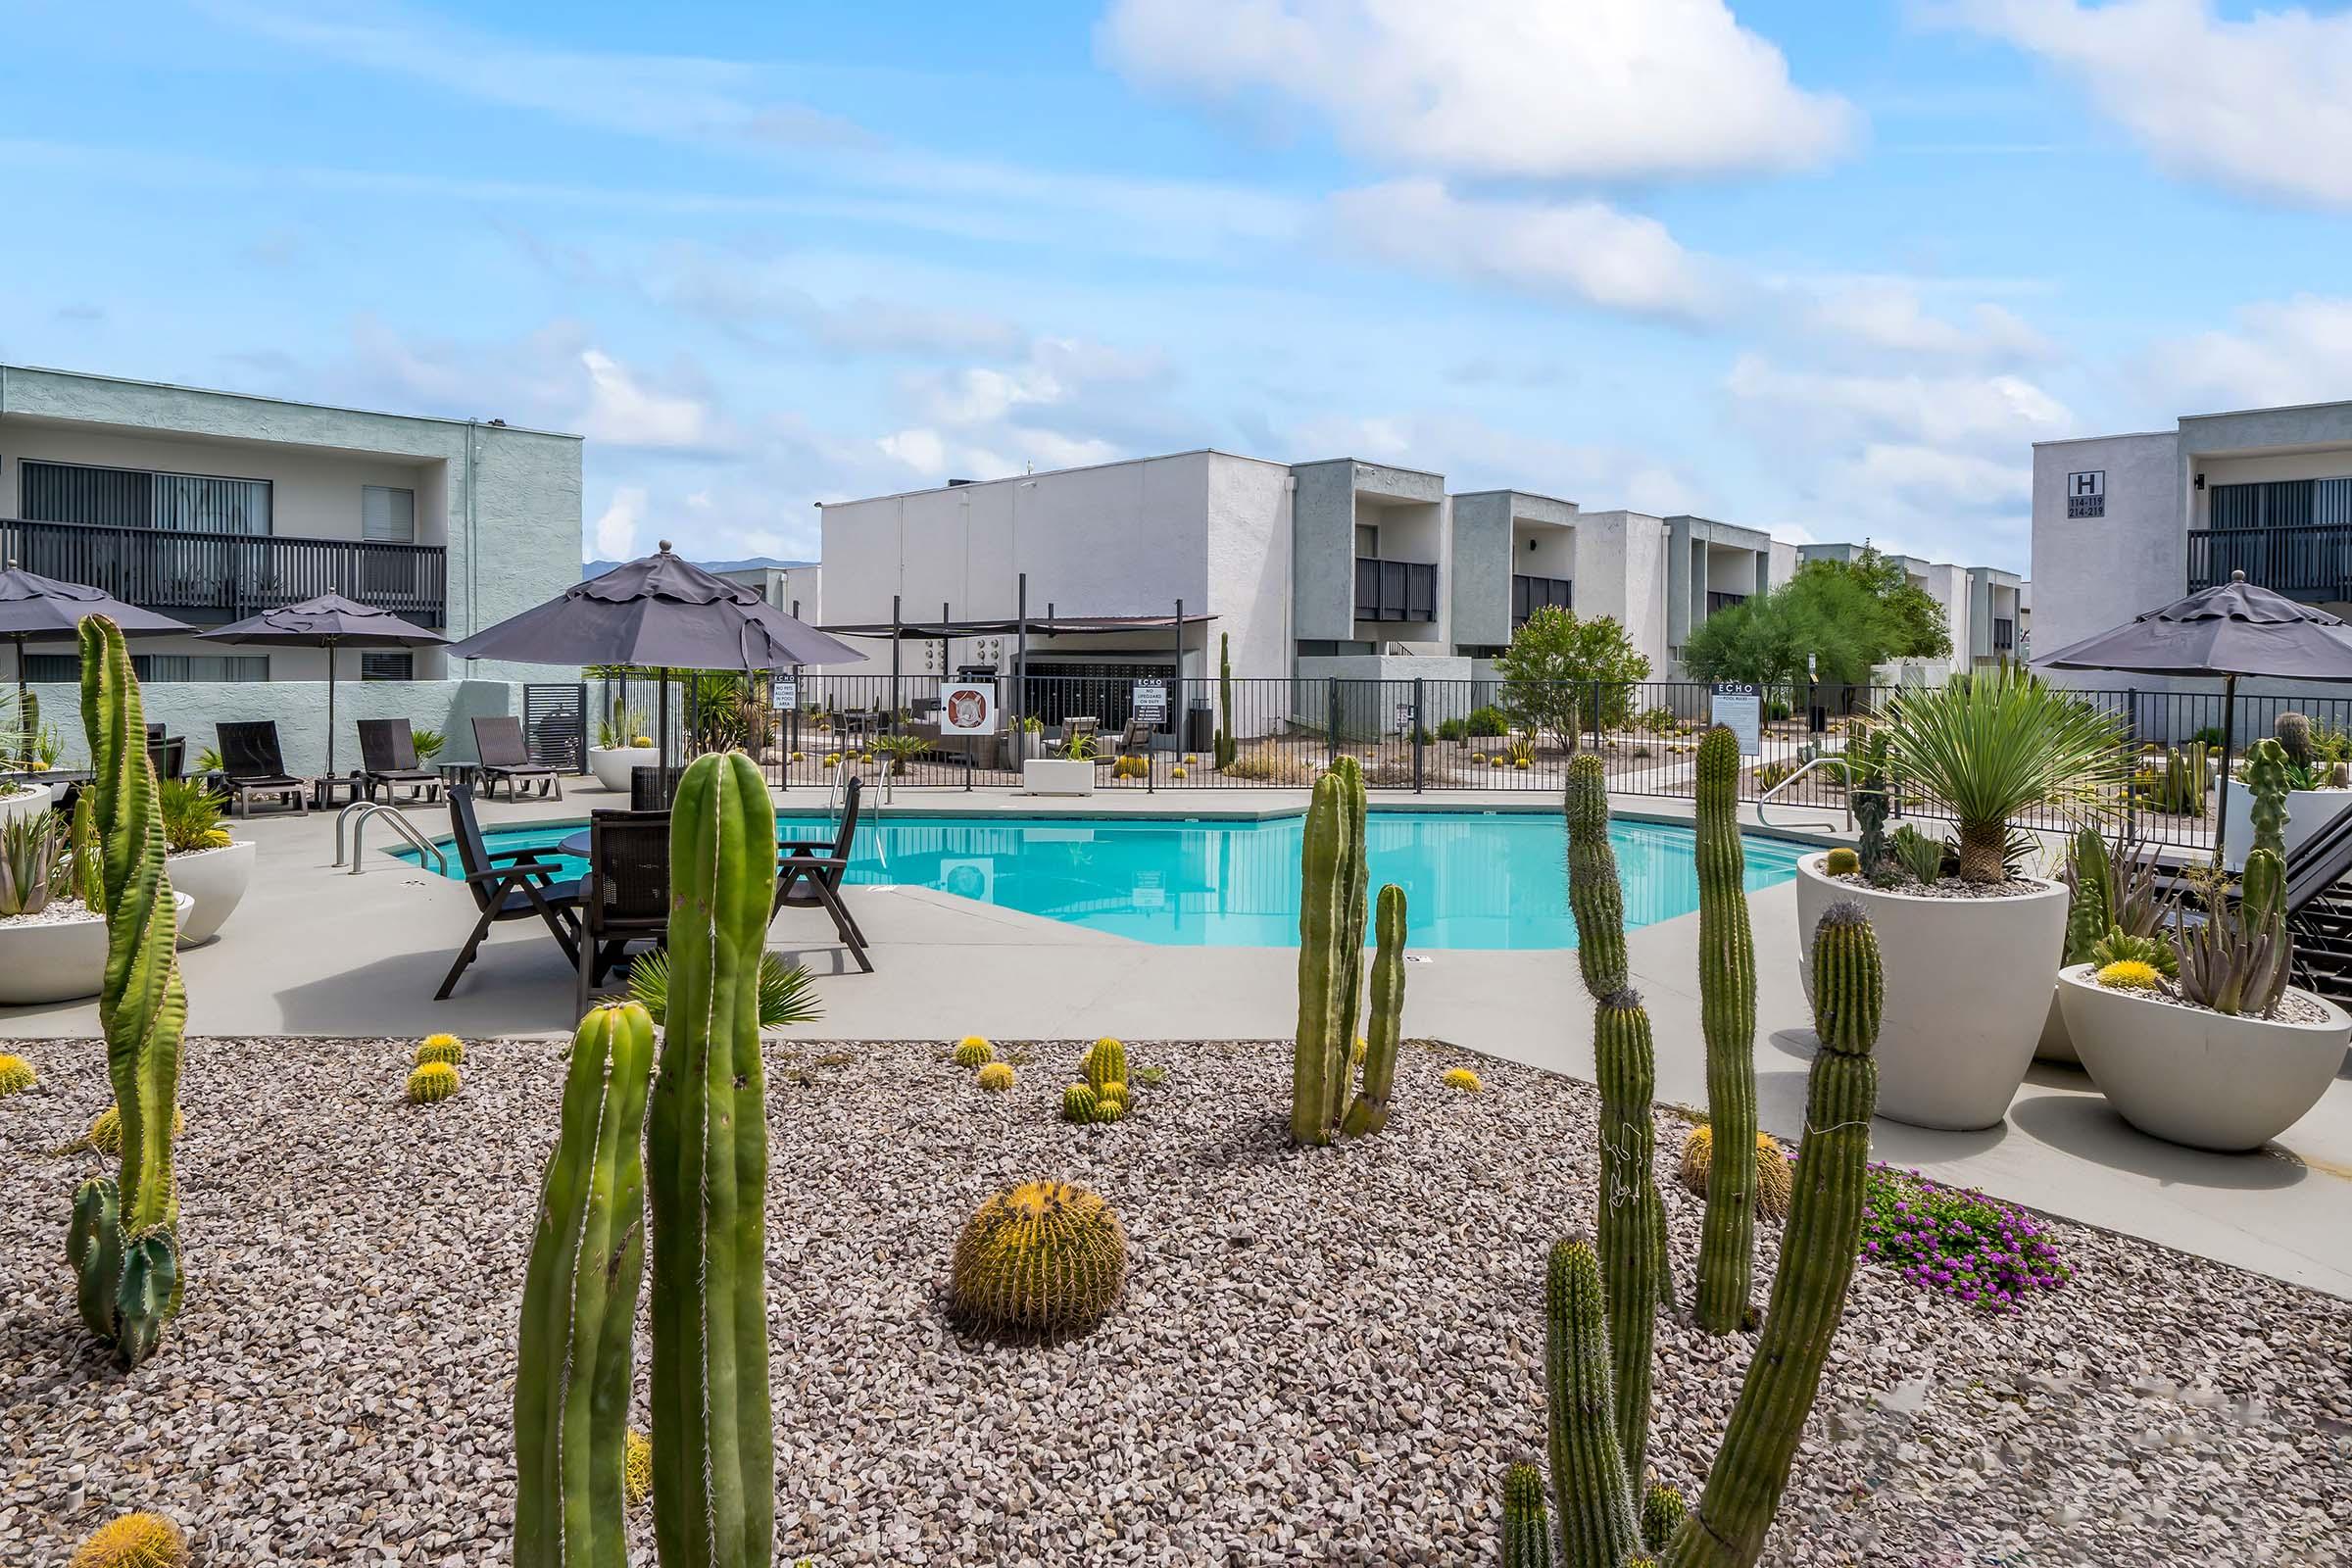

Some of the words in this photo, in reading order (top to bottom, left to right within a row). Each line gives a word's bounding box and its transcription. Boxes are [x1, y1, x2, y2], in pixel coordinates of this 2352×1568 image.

[2078, 474, 2094, 495] H
[2070, 497, 2103, 507] 114-119
[2070, 507, 2103, 517] 214-219
